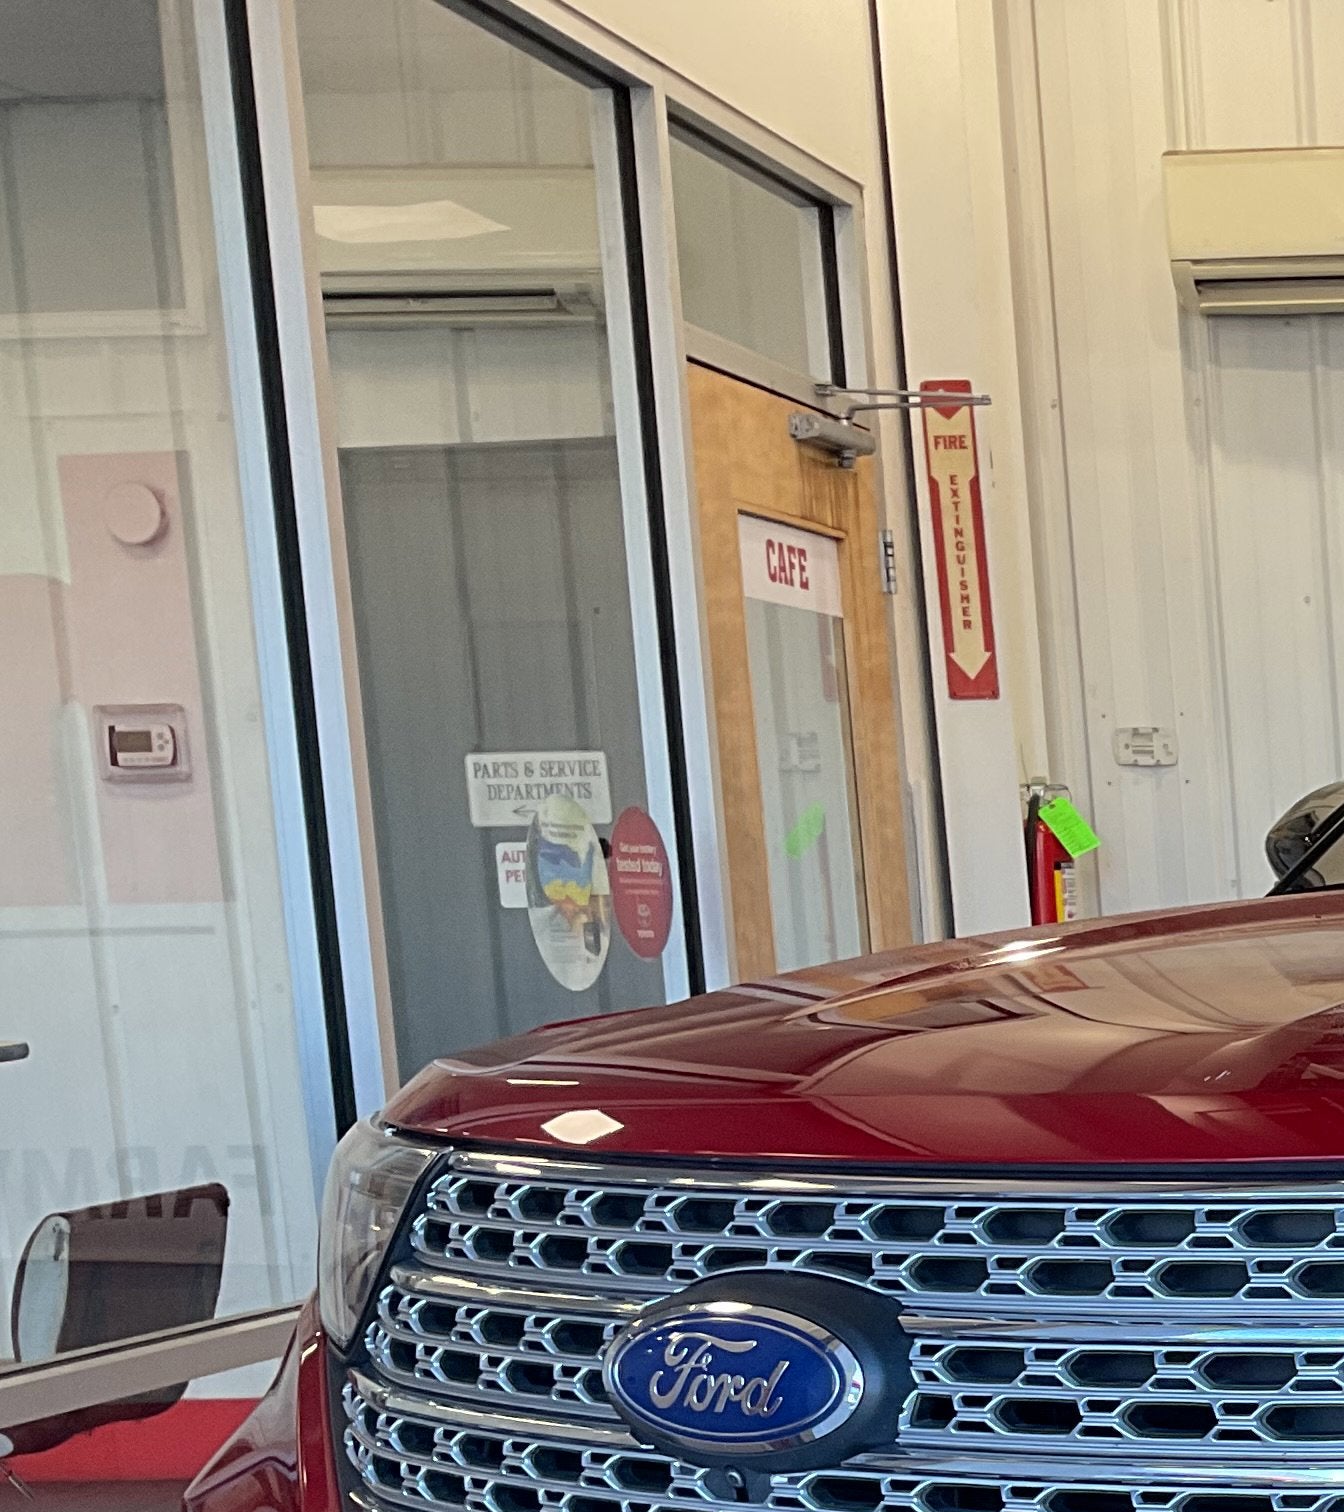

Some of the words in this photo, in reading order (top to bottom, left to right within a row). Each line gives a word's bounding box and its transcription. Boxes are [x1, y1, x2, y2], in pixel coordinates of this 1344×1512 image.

[933, 434, 967, 450] FIRE
[949, 474, 972, 630] EXTINGUISHER
[765, 538, 809, 590] CAFE
[473, 761, 519, 779] PARTS
[524, 761, 535, 778] &
[540, 759, 602, 778] SERVICE
[487, 782, 593, 801] DEPARTMENTS
[502, 850, 527, 863] AUT
[650, 1332, 788, 1417] Ford
